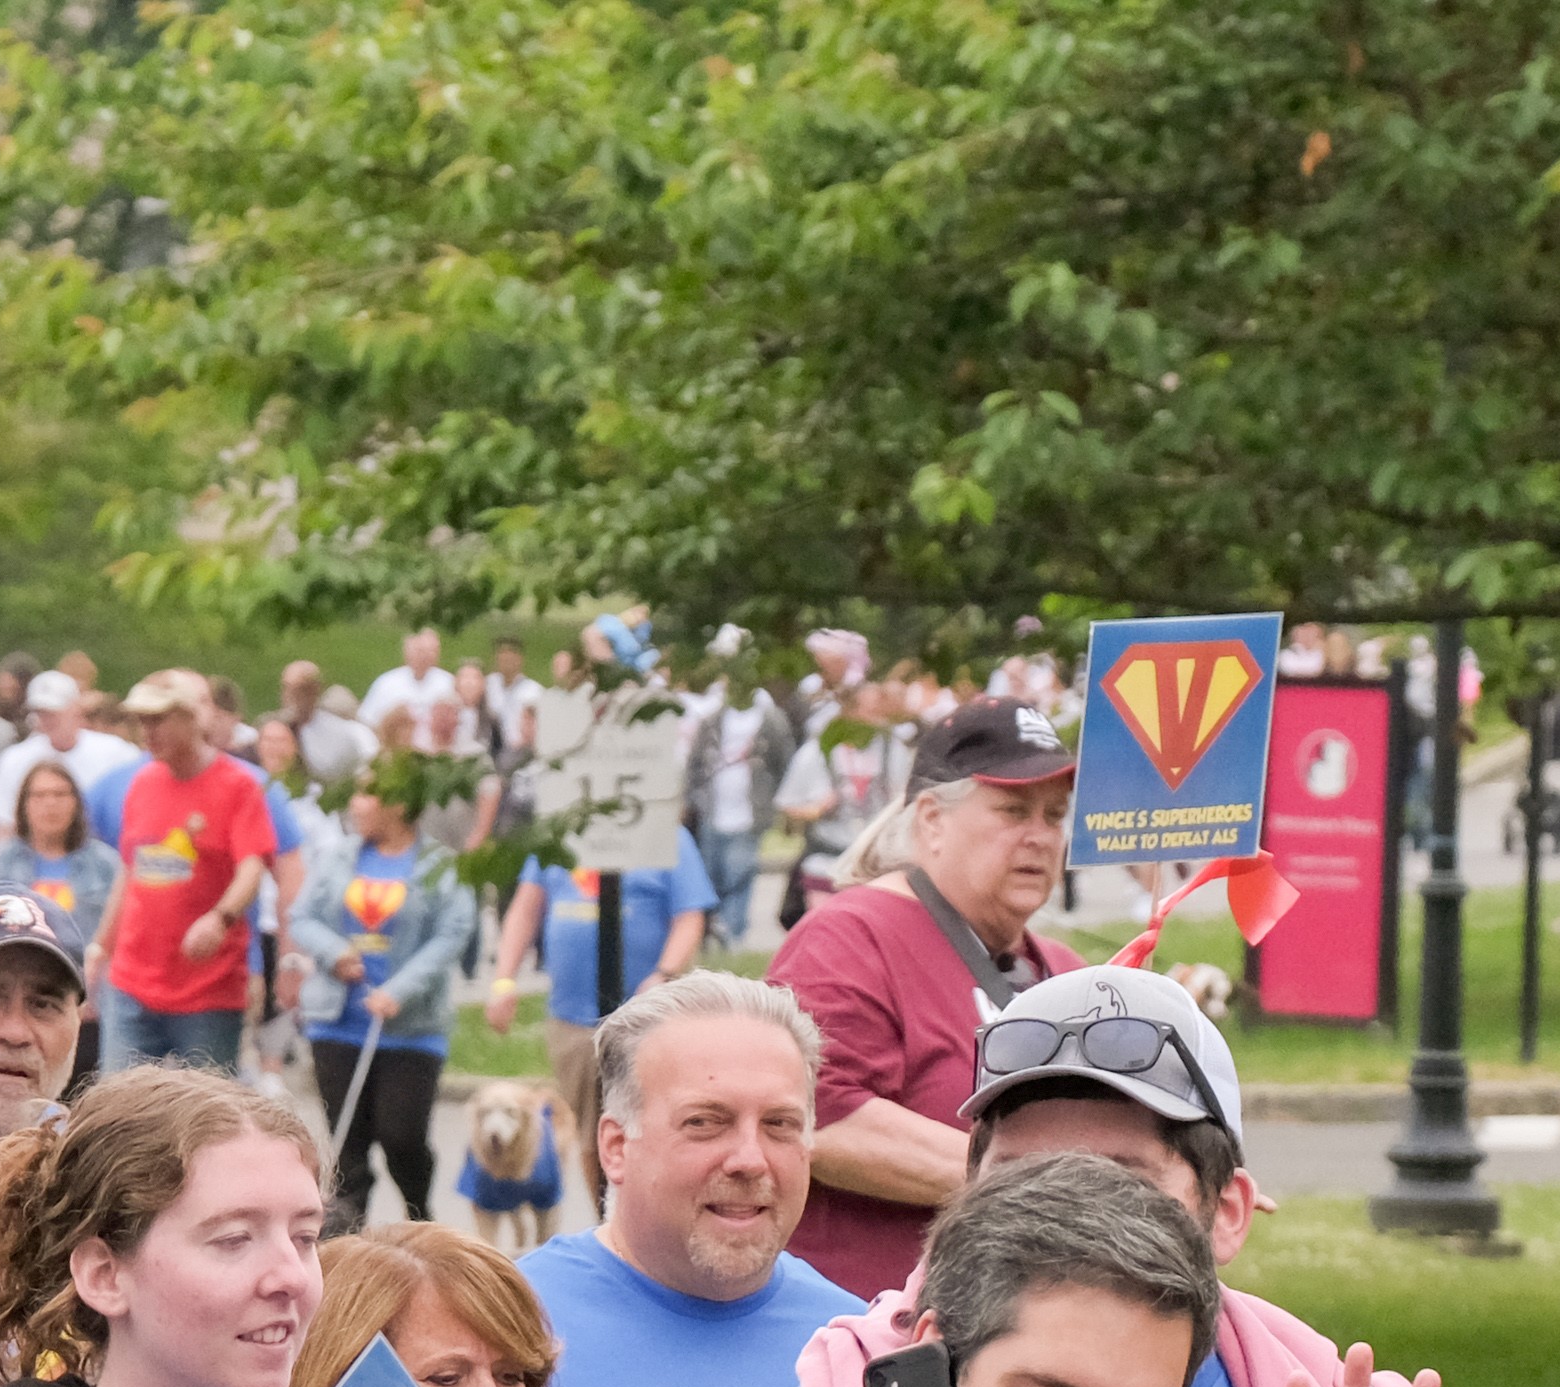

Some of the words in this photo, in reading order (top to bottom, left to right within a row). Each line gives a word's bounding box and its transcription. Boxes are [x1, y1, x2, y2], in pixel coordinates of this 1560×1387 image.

[1085, 808, 1148, 830] VINCE'S
[1151, 803, 1252, 828] SUPERHEROES
[1097, 835, 1138, 851] WALK
[1141, 833, 1158, 849] TO
[1161, 830, 1210, 848] DEFEAT
[1212, 828, 1238, 844] ALS
